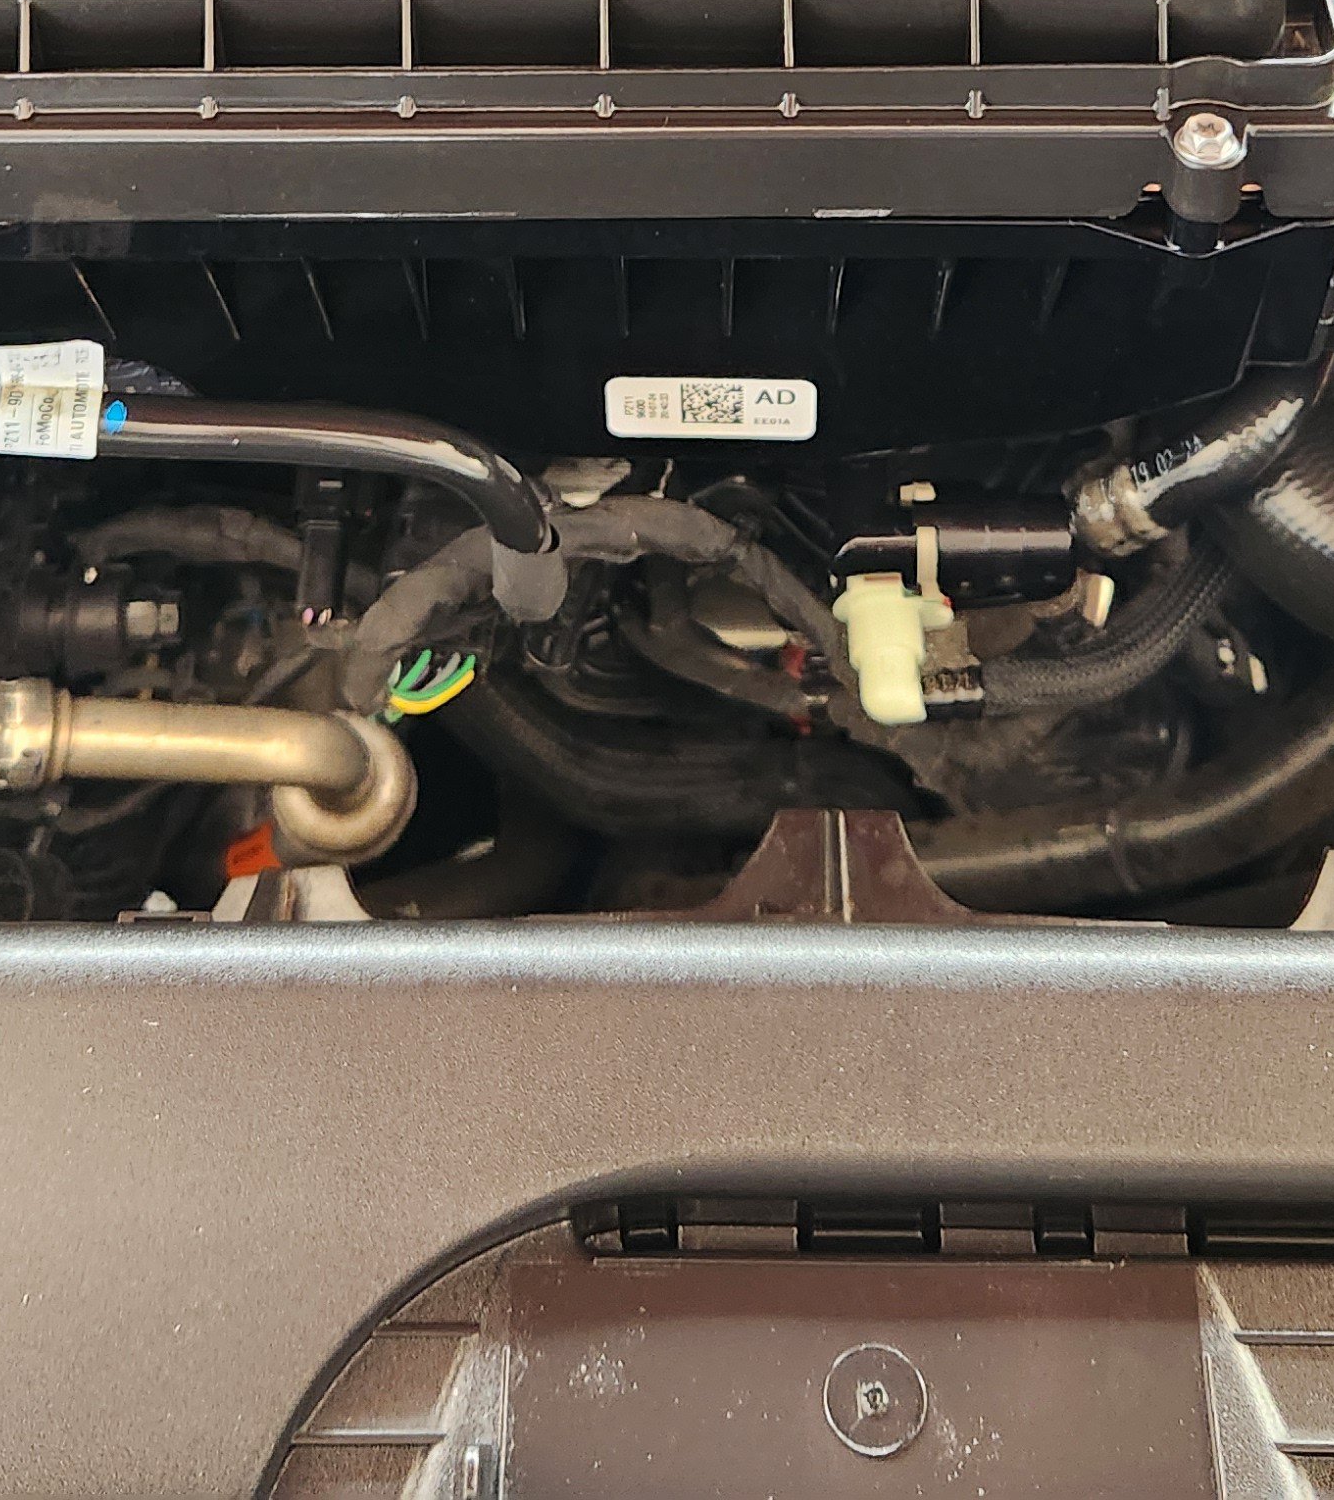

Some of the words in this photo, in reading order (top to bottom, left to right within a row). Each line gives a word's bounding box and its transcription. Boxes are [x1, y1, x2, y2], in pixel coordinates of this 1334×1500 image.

[755, 389, 796, 405] AD
[36, 397, 55, 446] FoMoCo
[753, 417, 791, 425] EE01A
